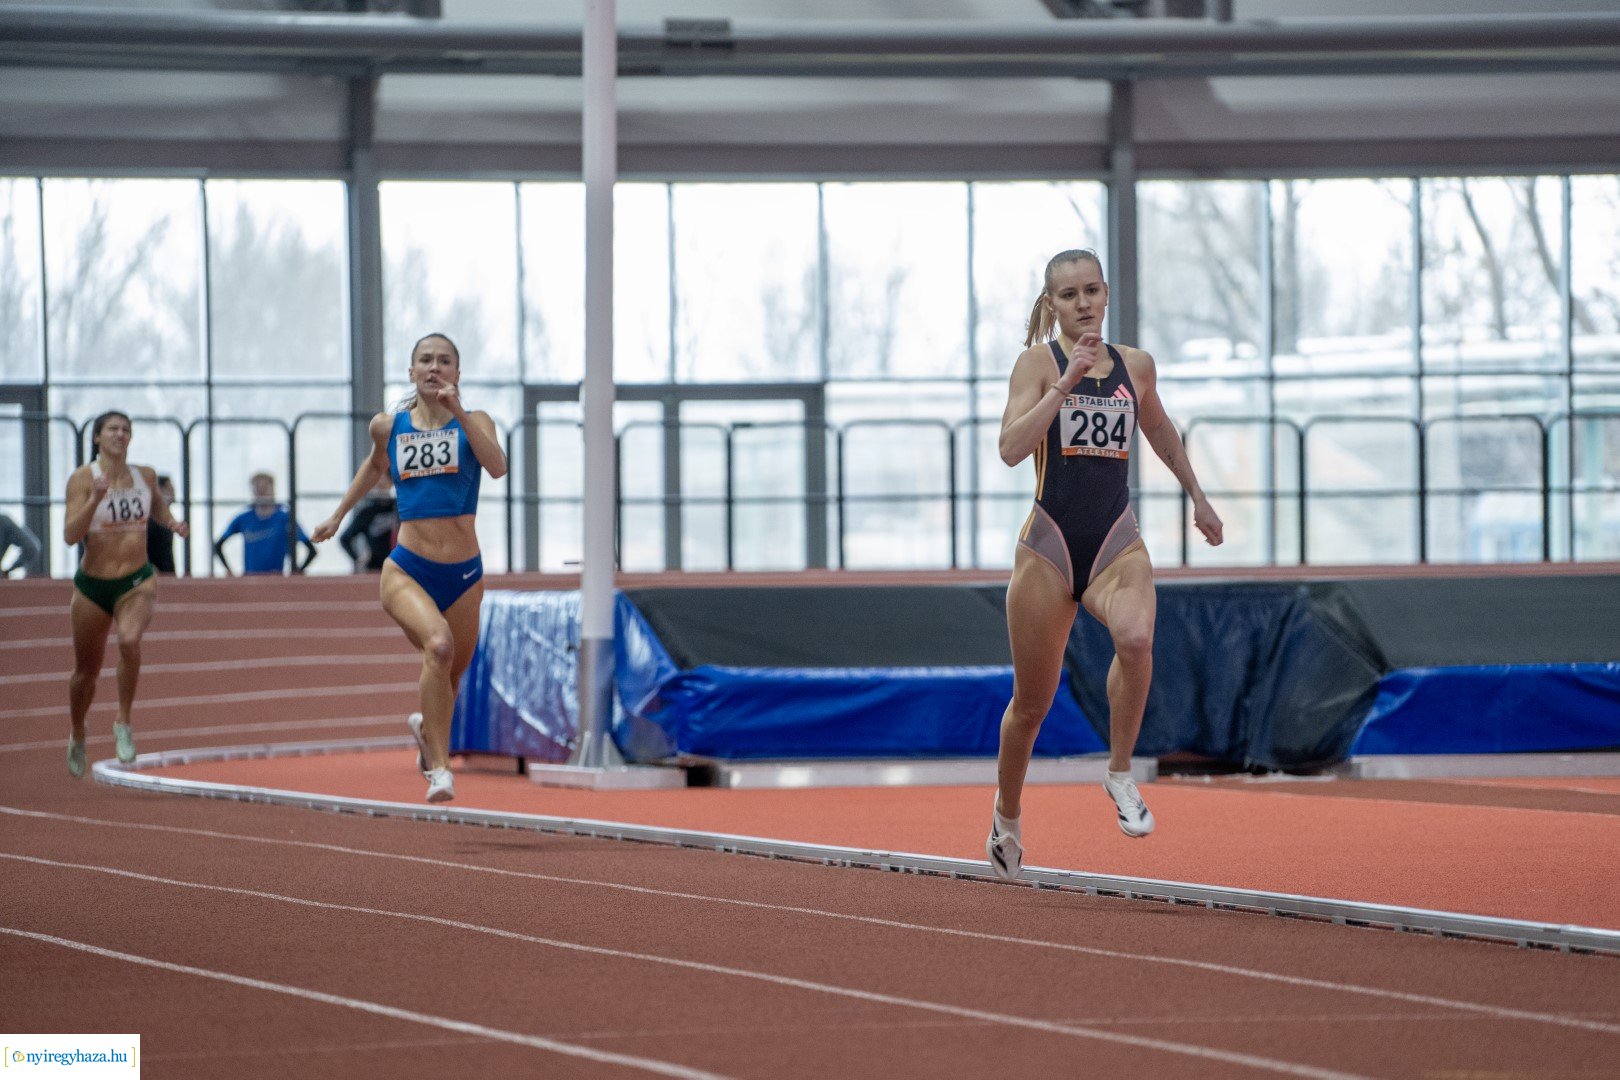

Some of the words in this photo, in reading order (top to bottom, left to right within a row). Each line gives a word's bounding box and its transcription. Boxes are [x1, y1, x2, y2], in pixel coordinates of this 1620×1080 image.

[1078, 396, 1130, 407] STABILITA
[1070, 410, 1127, 450] 284
[403, 441, 451, 470] 283
[1076, 448, 1121, 458] ATLETIKA
[107, 498, 144, 522] 183
